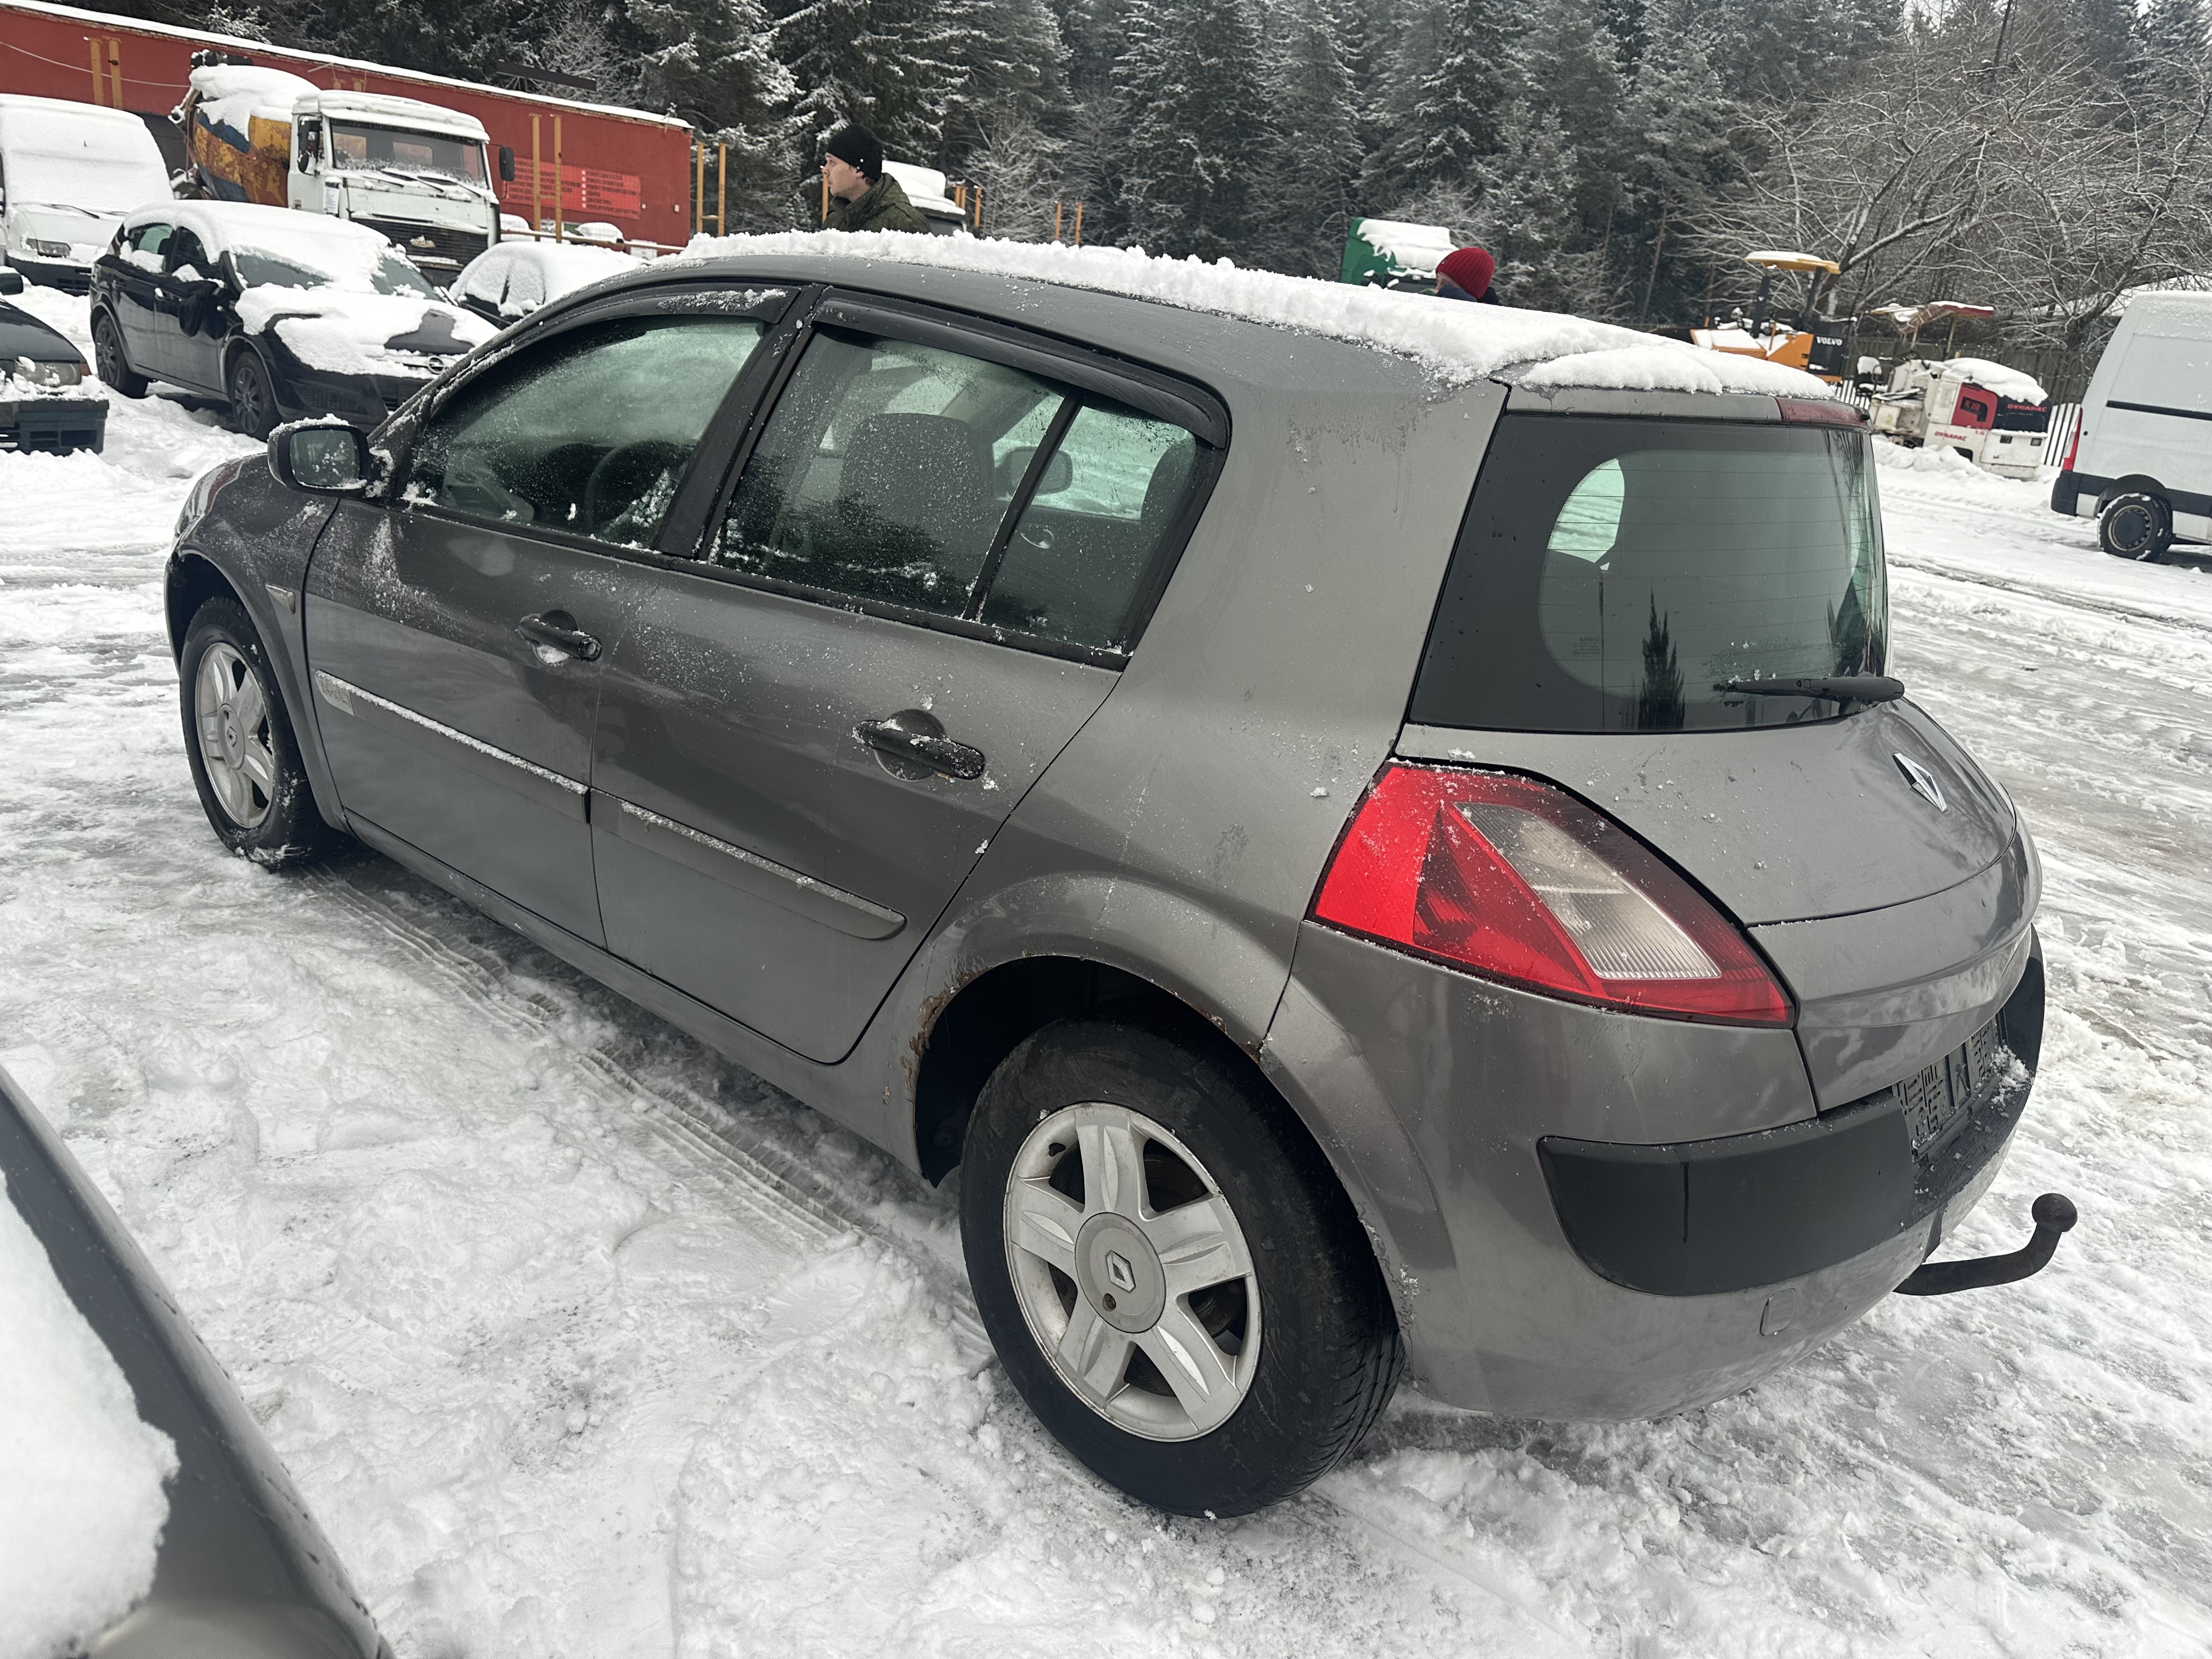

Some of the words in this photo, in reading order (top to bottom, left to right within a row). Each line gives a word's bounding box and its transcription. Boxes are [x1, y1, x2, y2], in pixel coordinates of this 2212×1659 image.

[1816, 336, 1843, 346] VOLVO
[2007, 403, 2047, 412] DYNAPAC
[1934, 431, 1967, 441] DYNAPAC
